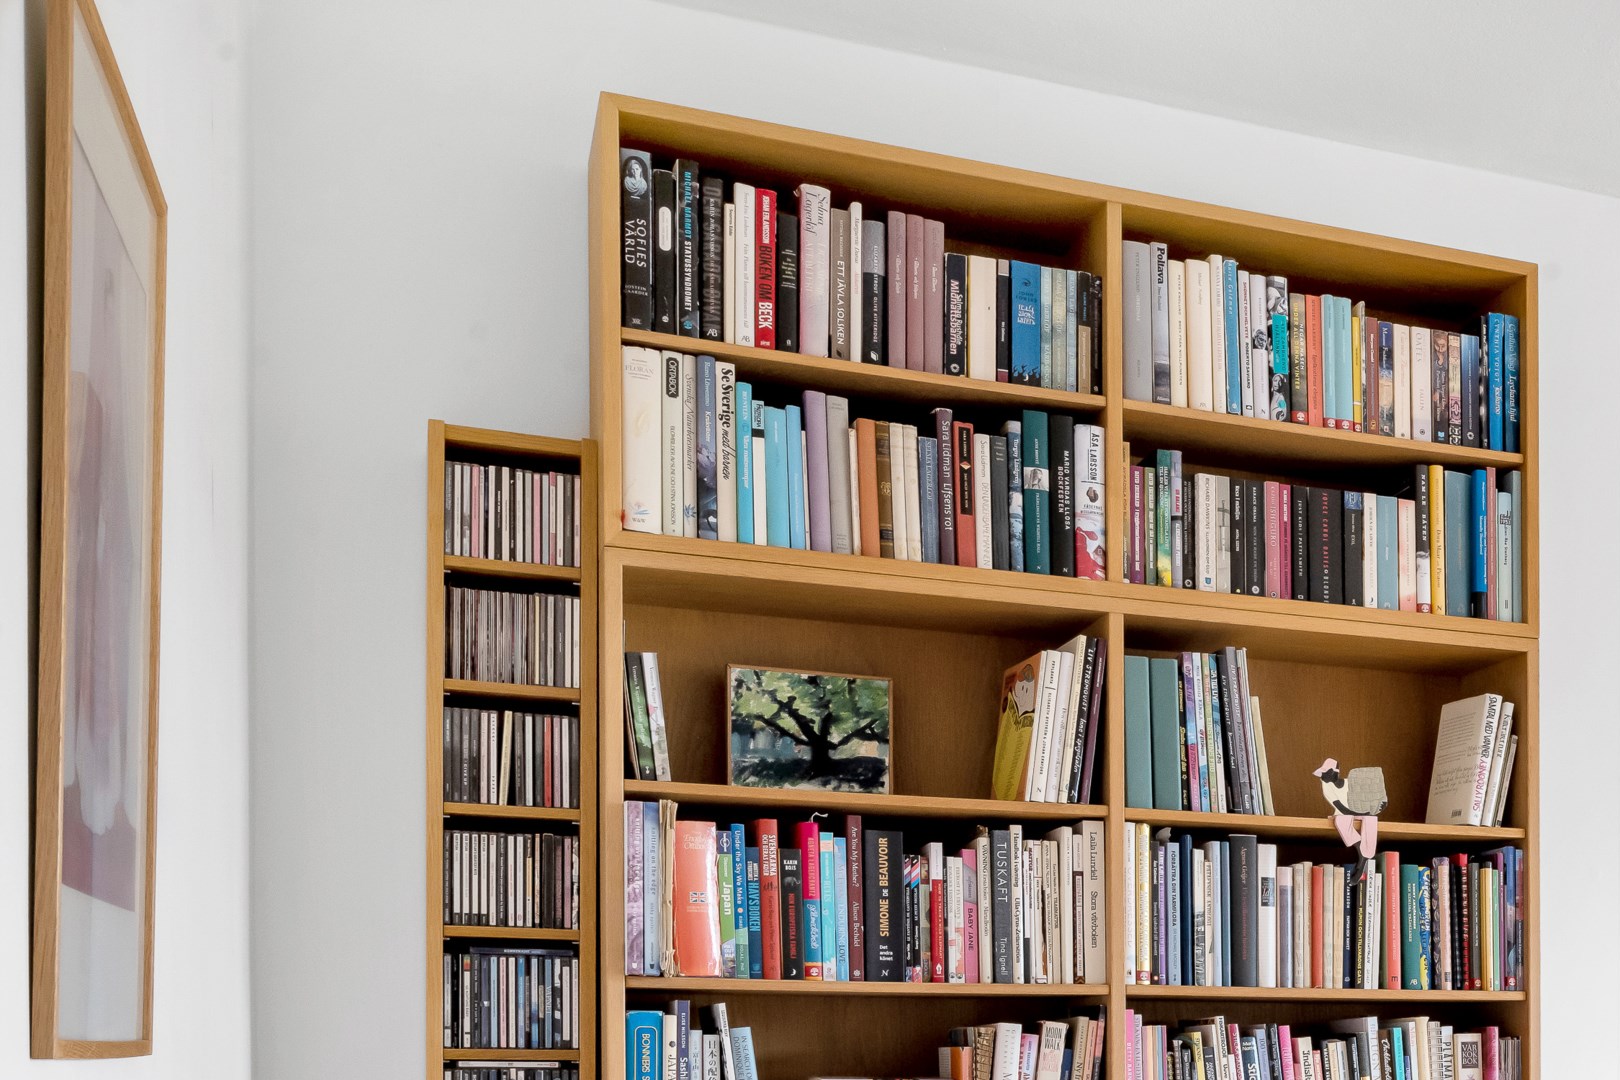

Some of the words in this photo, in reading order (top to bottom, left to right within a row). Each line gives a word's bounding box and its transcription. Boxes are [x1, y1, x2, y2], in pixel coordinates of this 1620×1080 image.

[625, 220, 637, 264] VÄRLD
[636, 218, 647, 269] SOFIES
[759, 245, 773, 281] BOKEN
[1156, 246, 1166, 284] Poltava
[759, 283, 773, 300] OM
[758, 302, 773, 330] BECK
[720, 367, 734, 383] Se
[718, 383, 734, 428] Sverige
[941, 420, 951, 441] Sara
[1091, 432, 1101, 448] ÅSA
[942, 443, 952, 478] Lidman
[1089, 449, 1099, 481] LARSSON
[944, 516, 953, 531] rot
[734, 830, 742, 851] Under
[733, 862, 742, 875] Sky
[878, 837, 889, 886] BEAUVOIR
[996, 842, 1008, 903] TUSKAFT
[721, 881, 732, 915] Japan
[748, 882, 760, 931] HAVSBOKEN
[879, 899, 889, 937] SIMONE
[1044, 1039, 1061, 1051] WALK
[1045, 1026, 1062, 1039] MOON
[641, 1033, 650, 1073] BONNIERS
